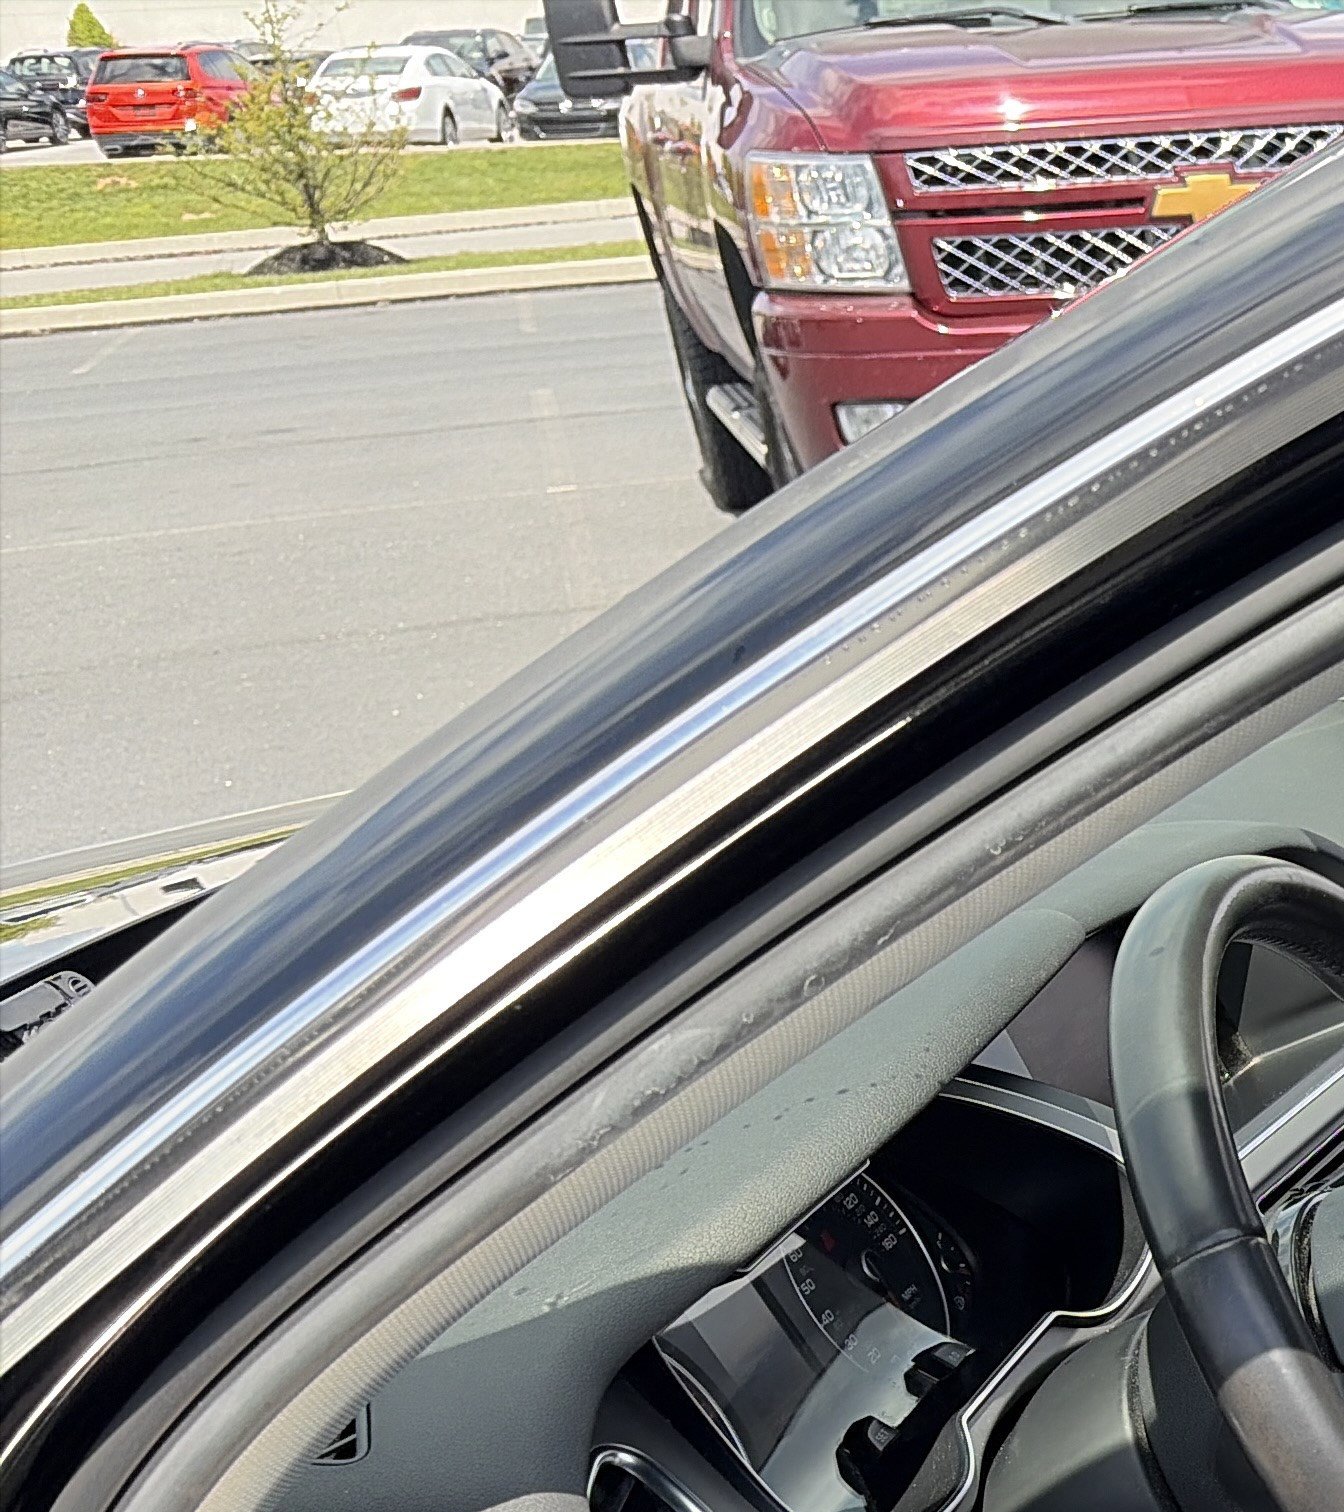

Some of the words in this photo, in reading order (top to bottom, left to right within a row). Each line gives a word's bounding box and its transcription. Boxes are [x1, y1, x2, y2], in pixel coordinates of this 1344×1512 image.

[864, 1211, 879, 1228] 140
[881, 1234, 898, 1252] 160
[801, 1279, 816, 1295] 50
[821, 1309, 835, 1326] 40
[845, 1333, 859, 1350] 30
